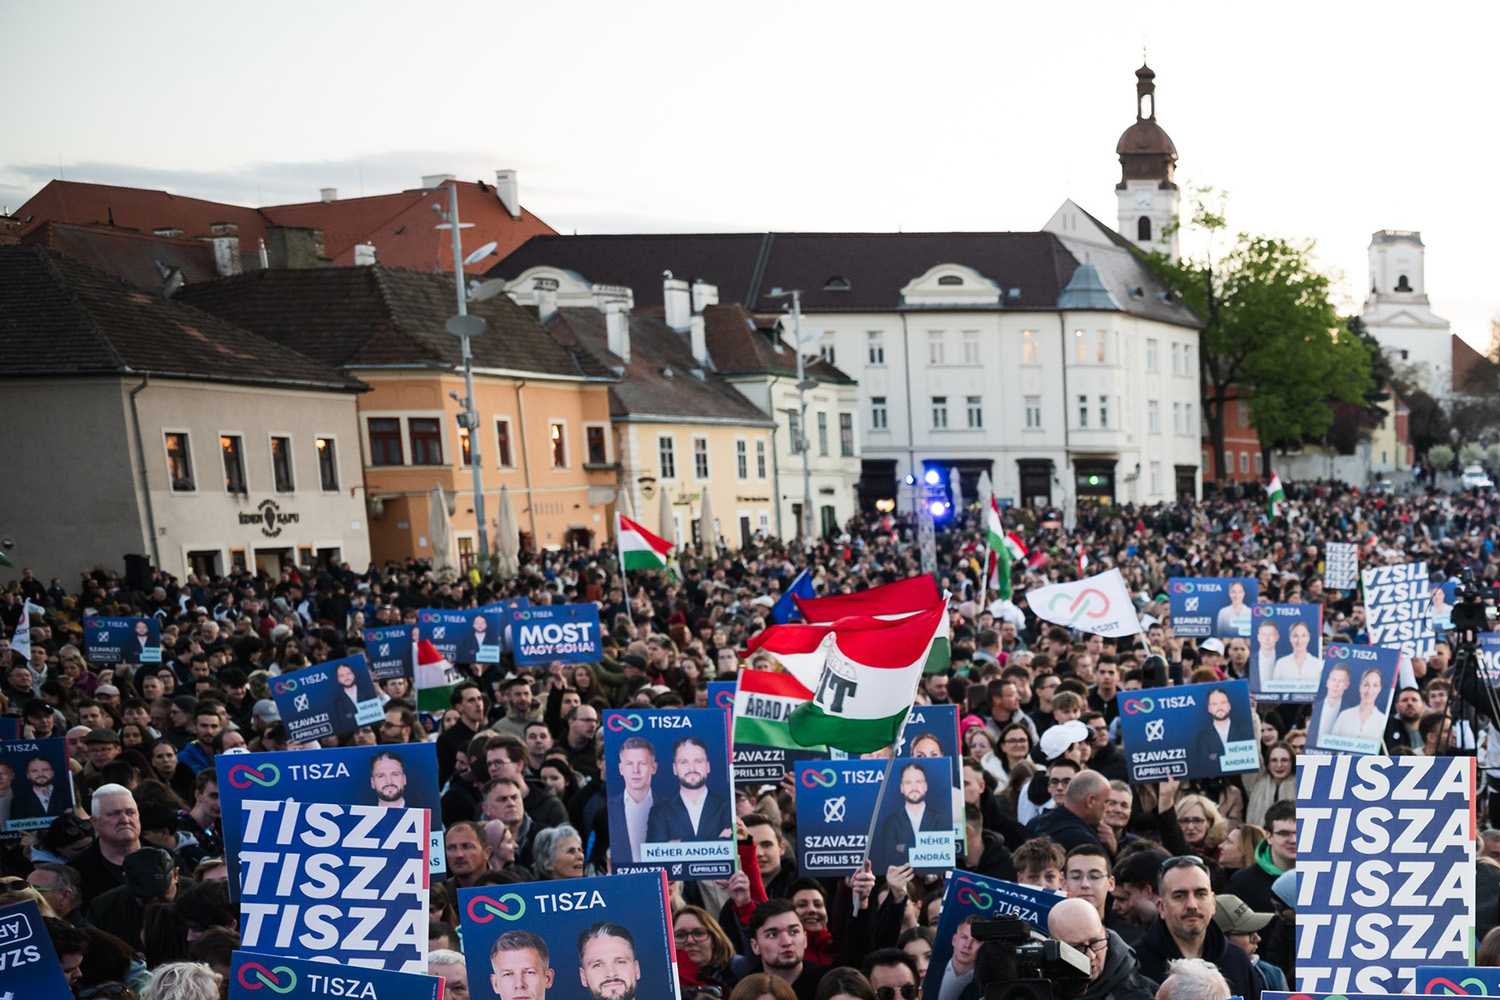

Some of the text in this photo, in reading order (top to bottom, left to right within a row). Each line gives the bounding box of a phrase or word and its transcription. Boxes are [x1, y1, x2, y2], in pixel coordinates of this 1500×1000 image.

[1363, 562, 1428, 586] TISZA
[1196, 583, 1222, 592] TISZA
[1365, 580, 1431, 605] TISZA
[1276, 607, 1301, 616] TISZA
[1368, 599, 1433, 625] TISZA
[444, 615, 466, 623] TISZA
[385, 630, 406, 638] TISZA
[520, 623, 593, 645] MOST
[1371, 618, 1435, 644] TISZA
[520, 642, 595, 656] VAGY SOHA!
[1352, 650, 1377, 660] TISZA
[299, 672, 329, 686] TISZA
[746, 694, 782, 720] ÁRAD
[1158, 695, 1196, 709] TISZA
[288, 712, 330, 731] SZAVAZZ!
[649, 716, 692, 729] TISZA
[6, 743, 39, 752] TISZA
[1132, 749, 1187, 764] SZAVAZZ!
[288, 763, 350, 781] TISZA
[767, 768, 780, 777] 12.
[842, 771, 884, 784] TISZA
[1138, 764, 1183, 778] ÁPRILIS 12.
[1296, 755, 1470, 801] TISZA
[241, 799, 425, 852] TISZA
[1296, 806, 1470, 854] TISZA
[805, 835, 869, 848] SZAVAZZ!
[920, 835, 950, 845] NÉHER
[646, 843, 730, 857] NÉHER ANDRÁS
[914, 850, 950, 862] ANDRÁS
[810, 851, 863, 865] ÁPRILIS 12.
[241, 851, 424, 901] TISZA
[692, 865, 717, 873] ÁPRILIS
[1296, 860, 1470, 907] TISZA
[535, 890, 606, 914] TISZA
[240, 902, 422, 952] TISZA
[1295, 912, 1469, 961] TISZA
[307, 974, 378, 1000] TISZA
